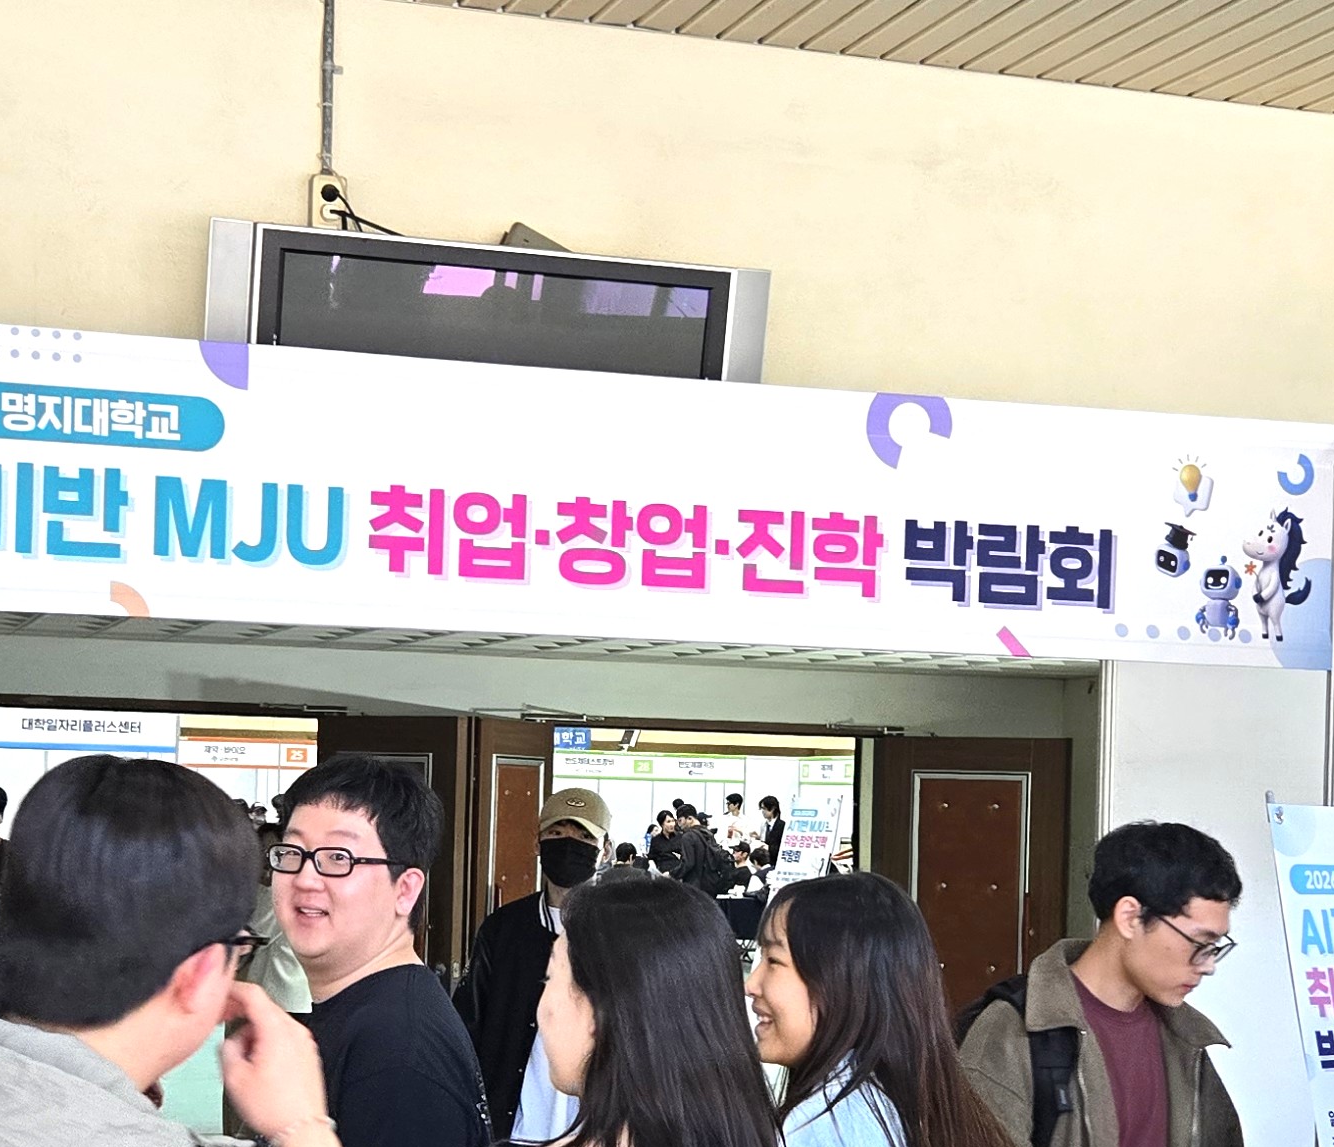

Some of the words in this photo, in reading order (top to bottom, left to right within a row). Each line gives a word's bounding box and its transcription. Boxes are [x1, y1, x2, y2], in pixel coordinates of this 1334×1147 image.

[0, 391, 181, 441] 명지대학교
[153, 475, 348, 568] MJU
[367, 484, 883, 599] 취업·창업·진학
[902, 518, 1117, 612] 박람회
[21, 717, 142, 734] 대학일자리플러스센터
